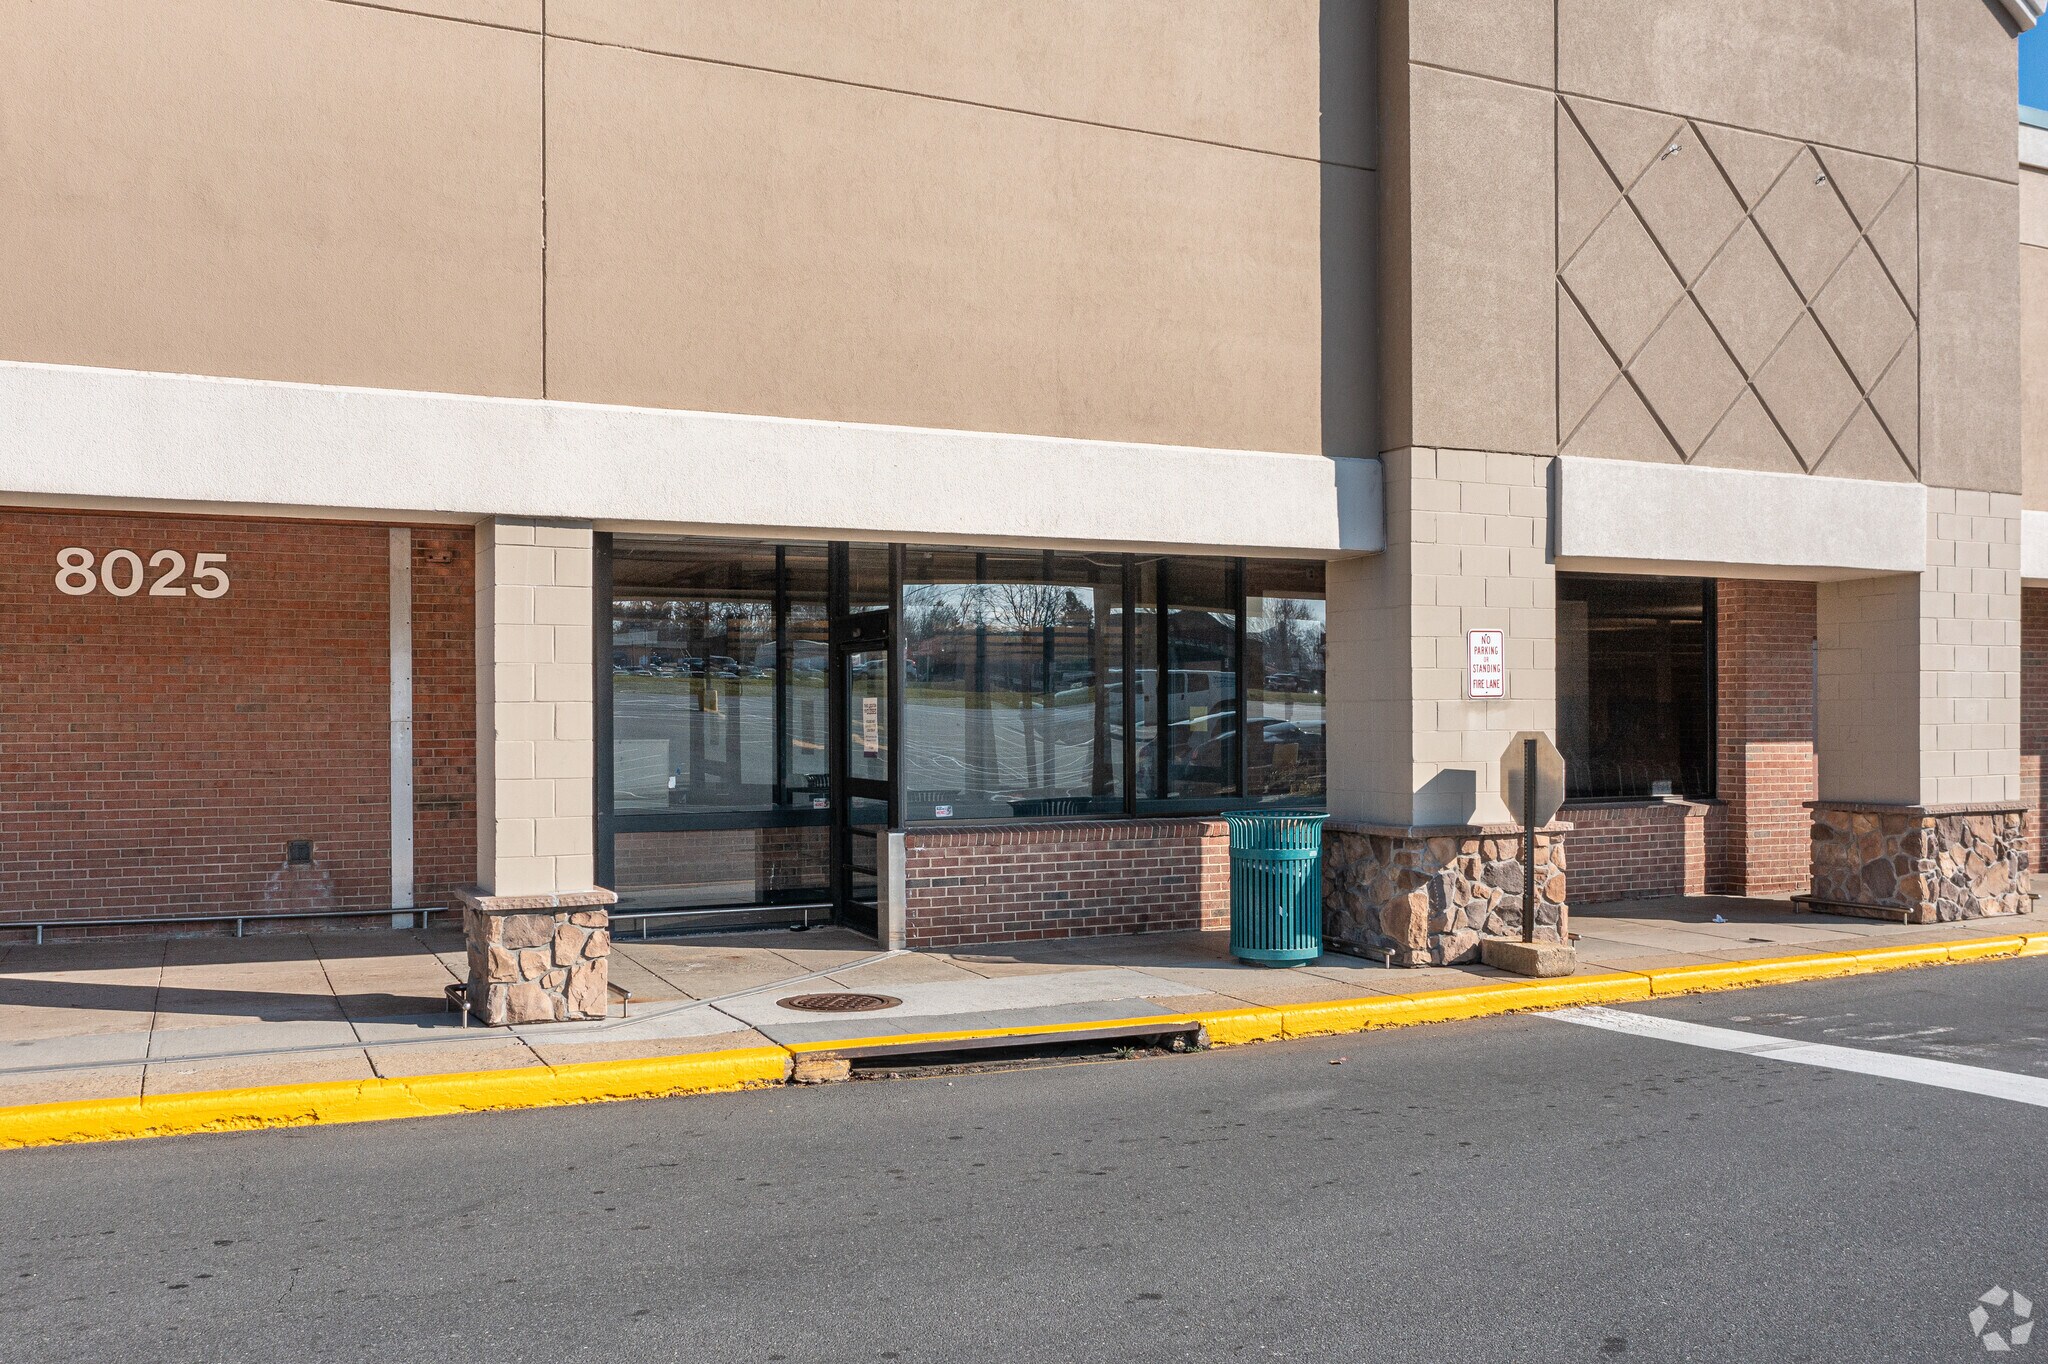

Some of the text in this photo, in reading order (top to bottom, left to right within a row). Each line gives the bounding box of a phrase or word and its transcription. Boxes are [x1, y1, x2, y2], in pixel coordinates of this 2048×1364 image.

[55, 547, 230, 599] 8025
[1482, 636, 1490, 644] NO
[1474, 646, 1498, 655] PARKING
[1473, 664, 1500, 673] STANDING
[1473, 679, 1500, 688] FIRE LANE
